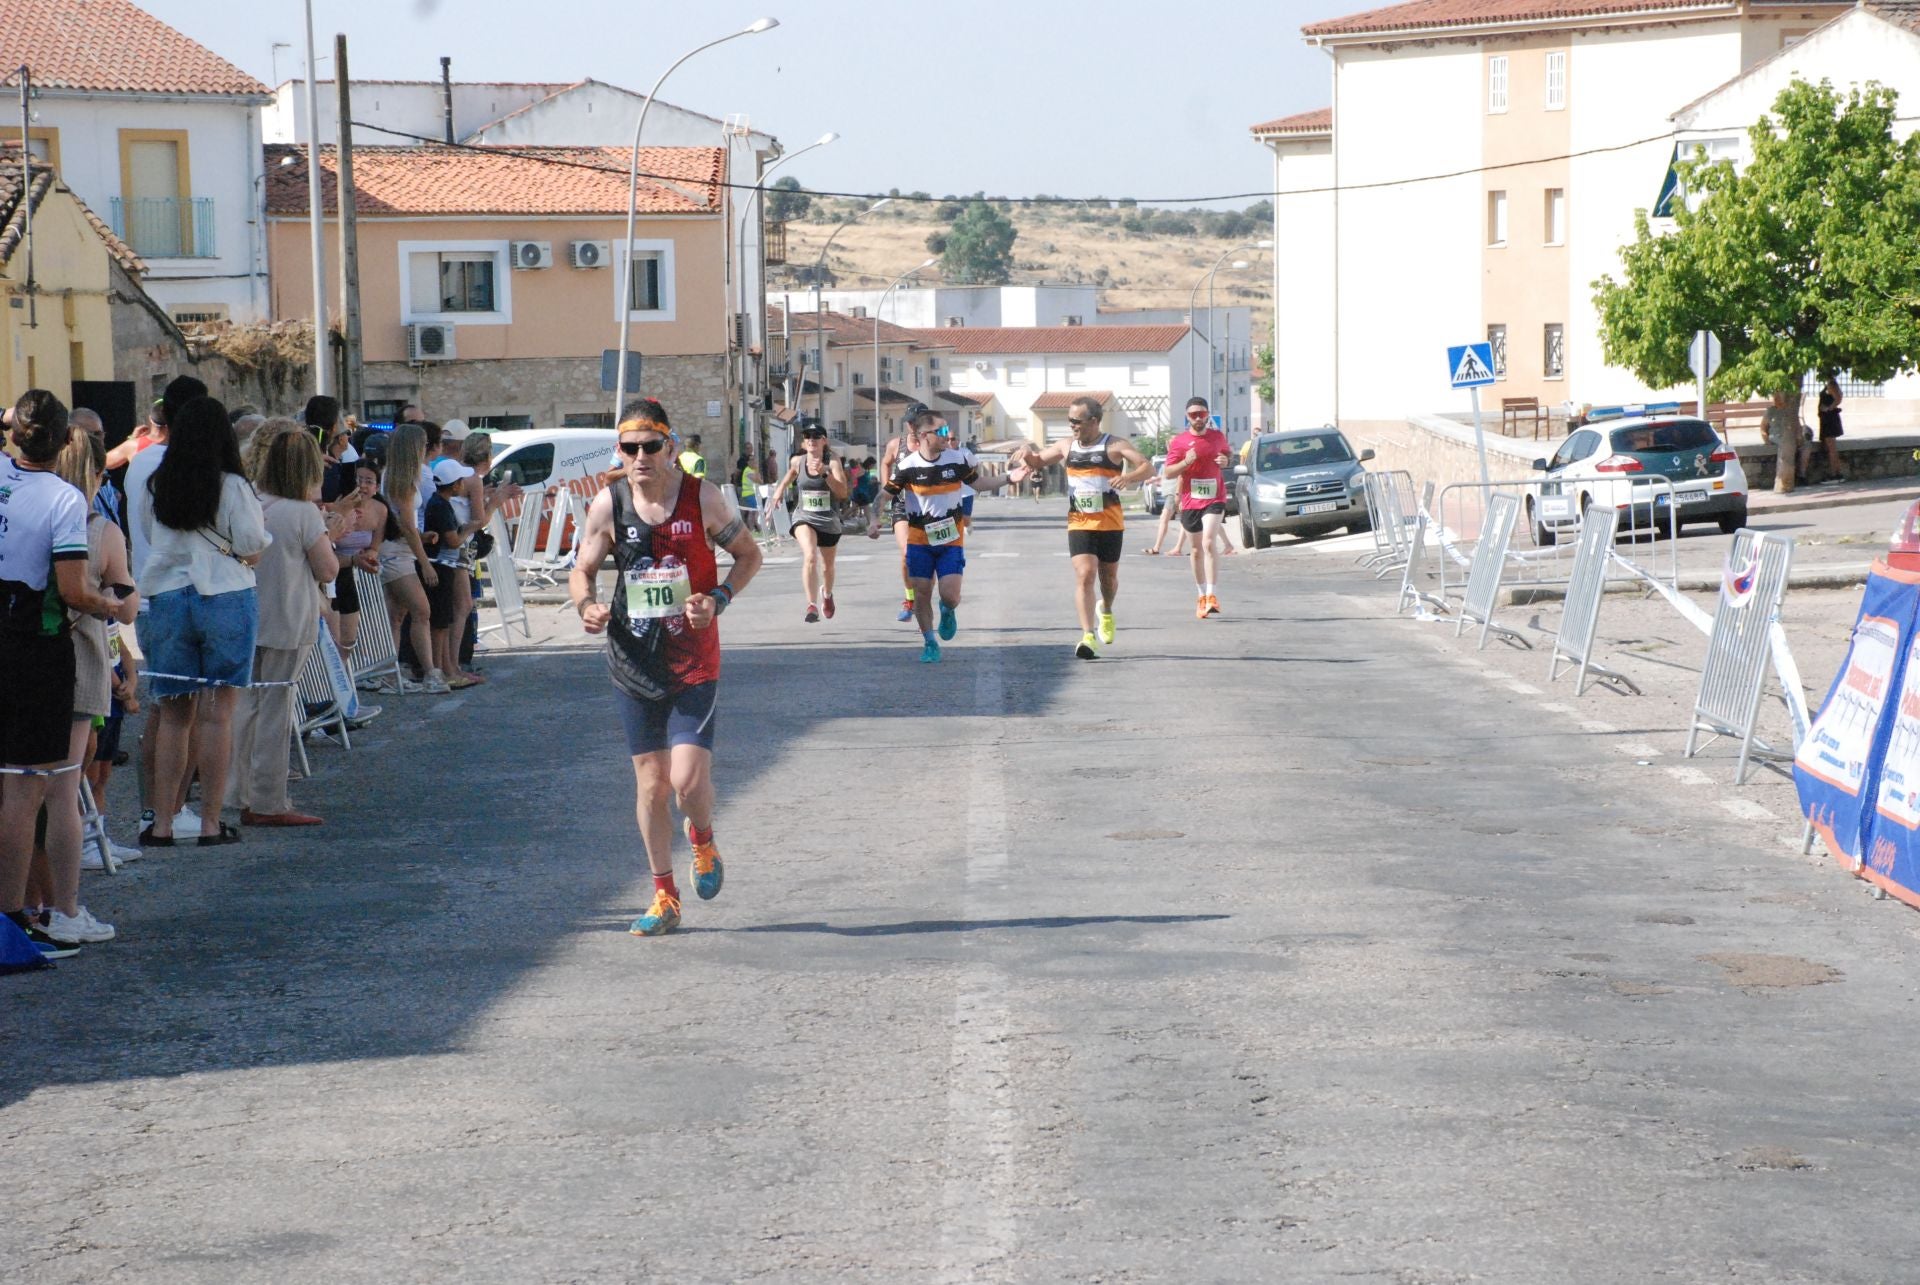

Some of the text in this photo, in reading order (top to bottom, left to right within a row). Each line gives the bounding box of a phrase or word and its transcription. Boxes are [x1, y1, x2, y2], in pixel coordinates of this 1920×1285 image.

[560, 446, 611, 467] organización
[1198, 486, 1210, 495] 211
[809, 498, 823, 507] 194
[1080, 497, 1093, 508] 55
[934, 526, 952, 540] 207
[644, 586, 674, 607] 170
